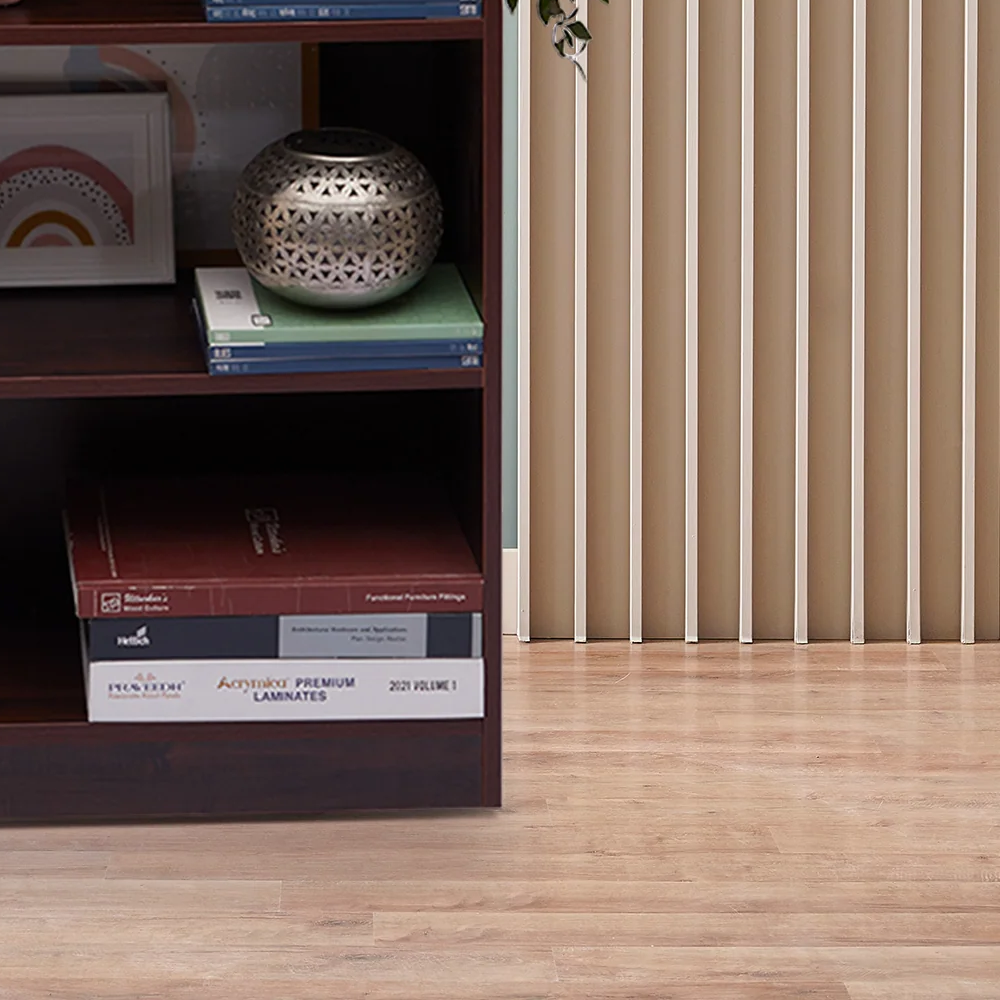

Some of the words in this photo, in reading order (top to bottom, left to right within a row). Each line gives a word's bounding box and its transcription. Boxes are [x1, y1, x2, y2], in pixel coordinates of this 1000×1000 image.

[365, 593, 403, 603] Functional
[404, 593, 437, 602] Furniture
[439, 592, 466, 603] Fittings
[291, 625, 329, 633] Architectural
[116, 635, 150, 647] Hettich
[216, 676, 287, 694] Acrymica
[295, 677, 355, 689] PREMIUM
[389, 680, 411, 692] 2021
[413, 680, 450, 692] VOLUME
[253, 690, 327, 702] LAMINATES
